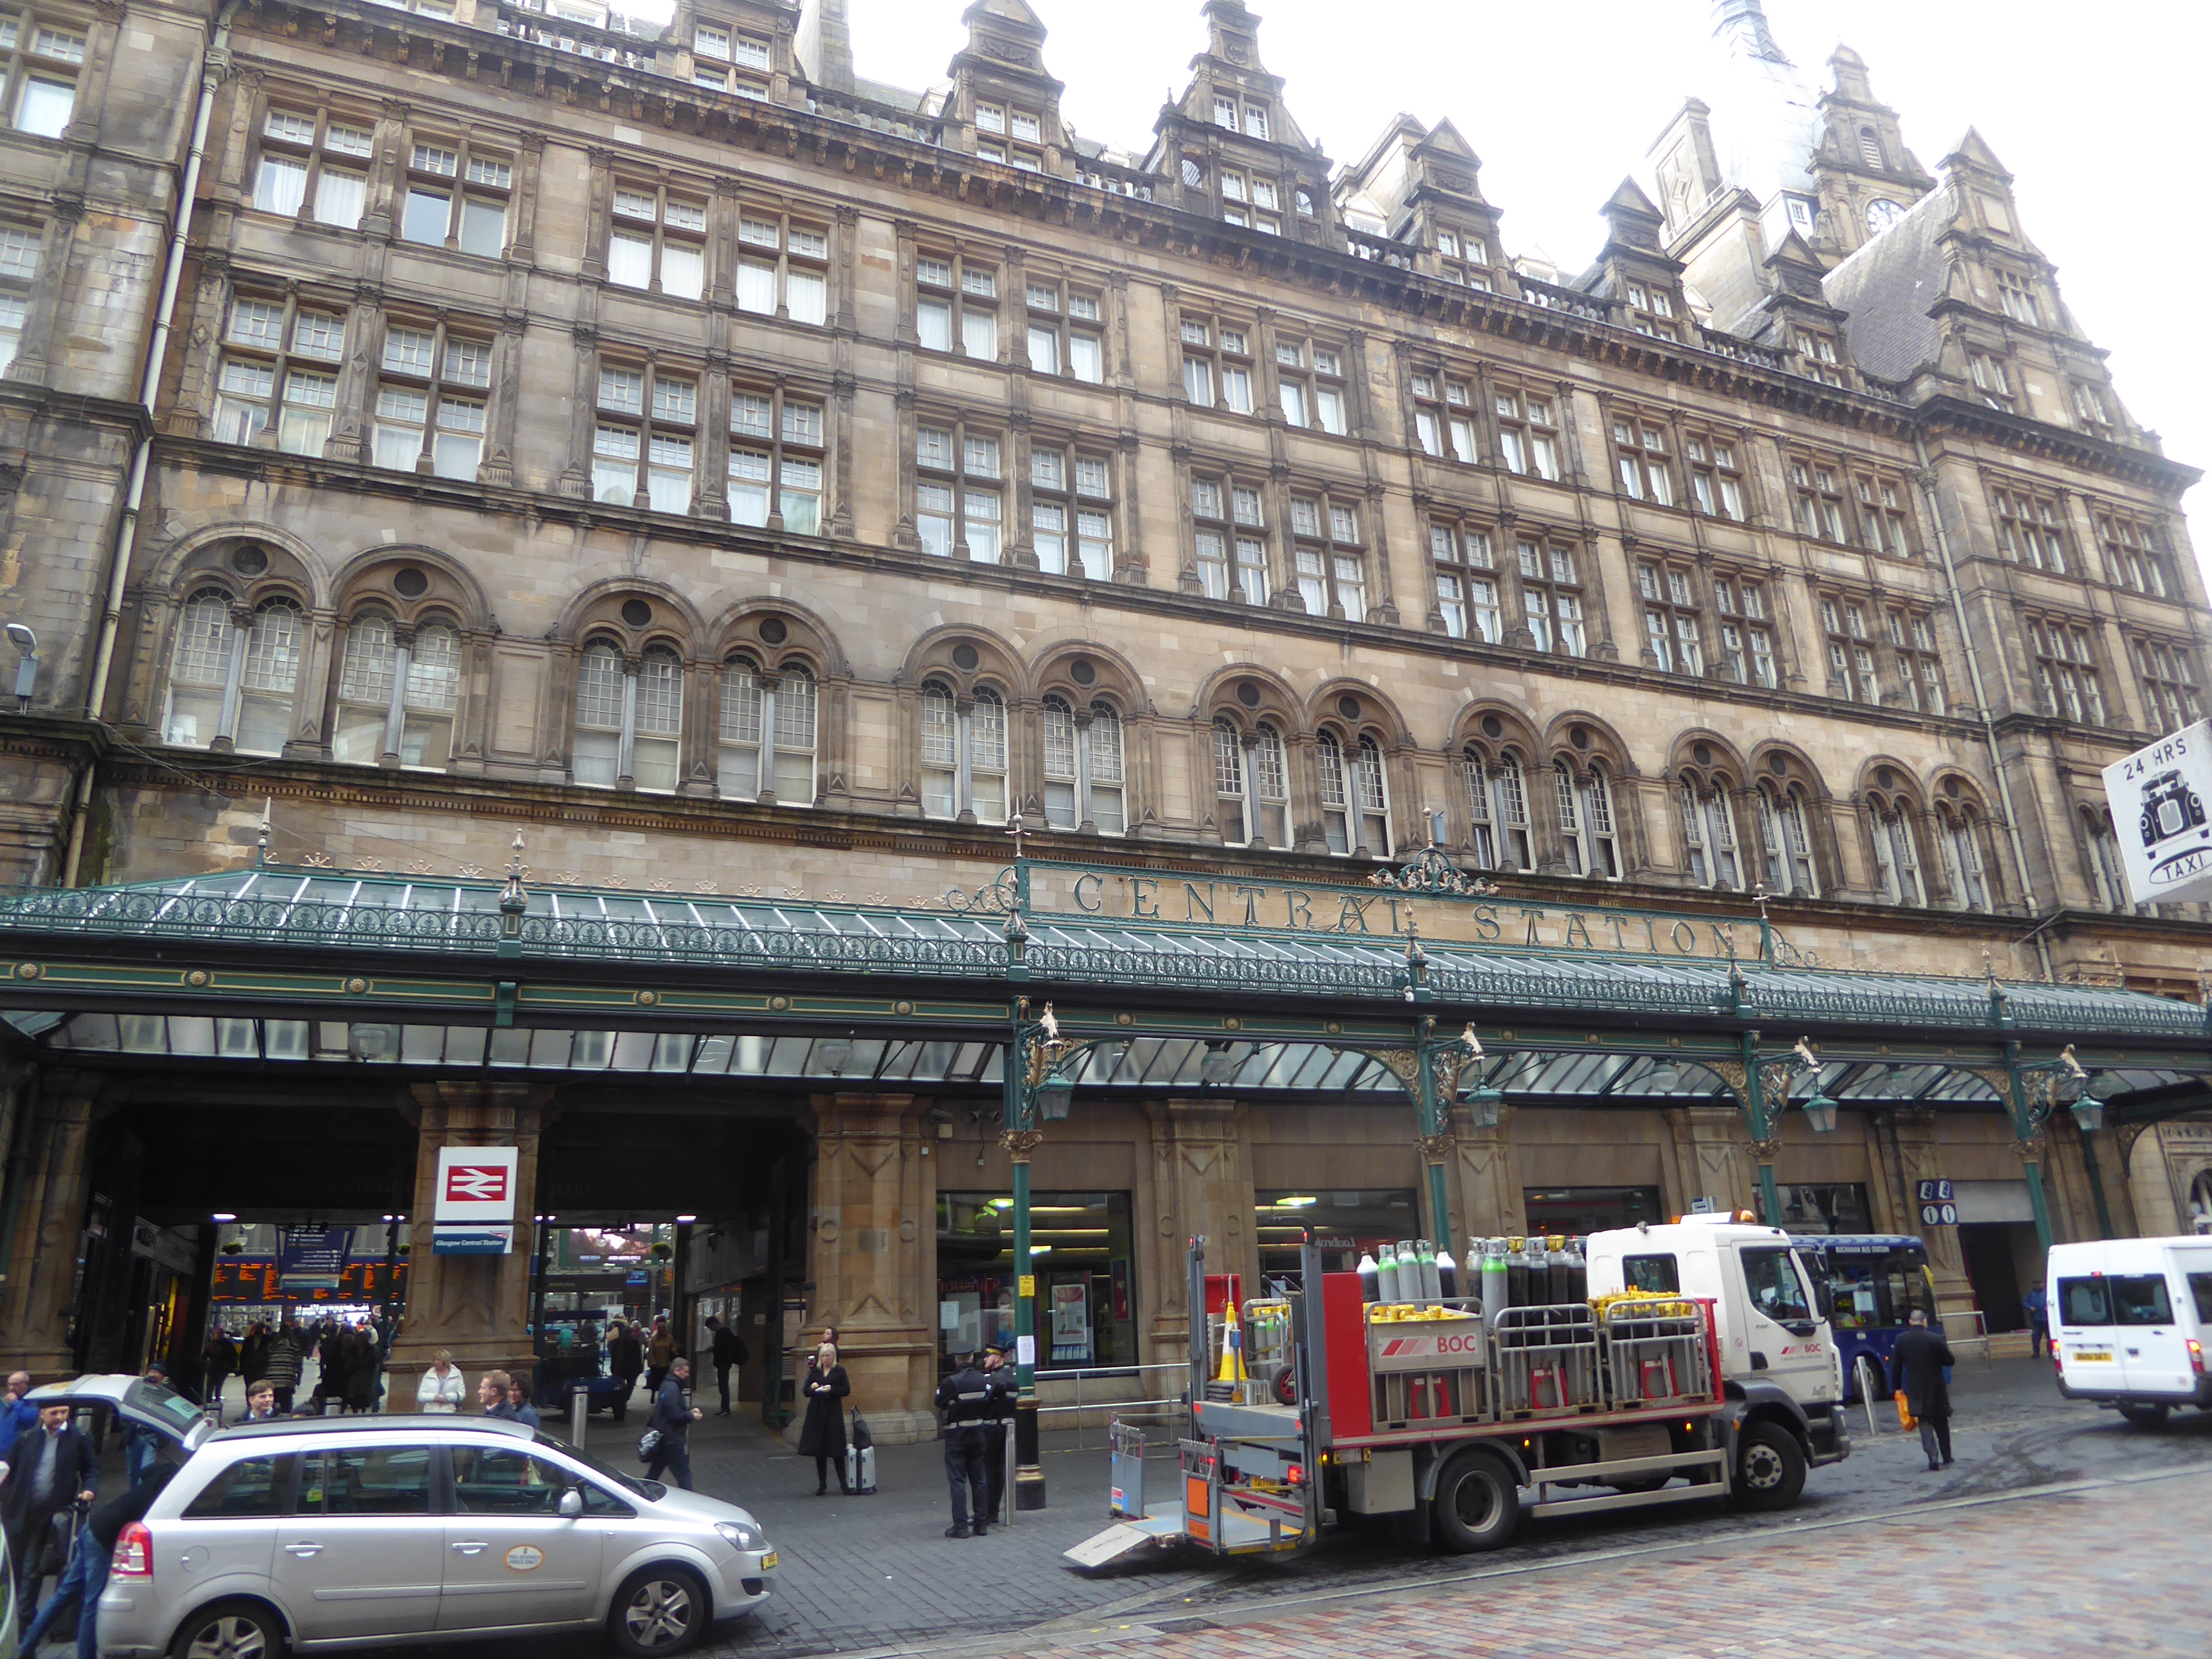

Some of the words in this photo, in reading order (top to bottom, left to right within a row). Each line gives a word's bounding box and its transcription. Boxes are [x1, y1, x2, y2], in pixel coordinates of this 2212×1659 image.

[2124, 758, 2144, 780] 24
[2153, 738, 2186, 766] HRS
[2163, 853, 2203, 880] TAXI
[1072, 871, 1407, 935] CENTRAL
[1473, 904, 1736, 957] STATION
[1437, 1335, 1476, 1353] BOC
[1804, 1343, 1821, 1353] BOC
